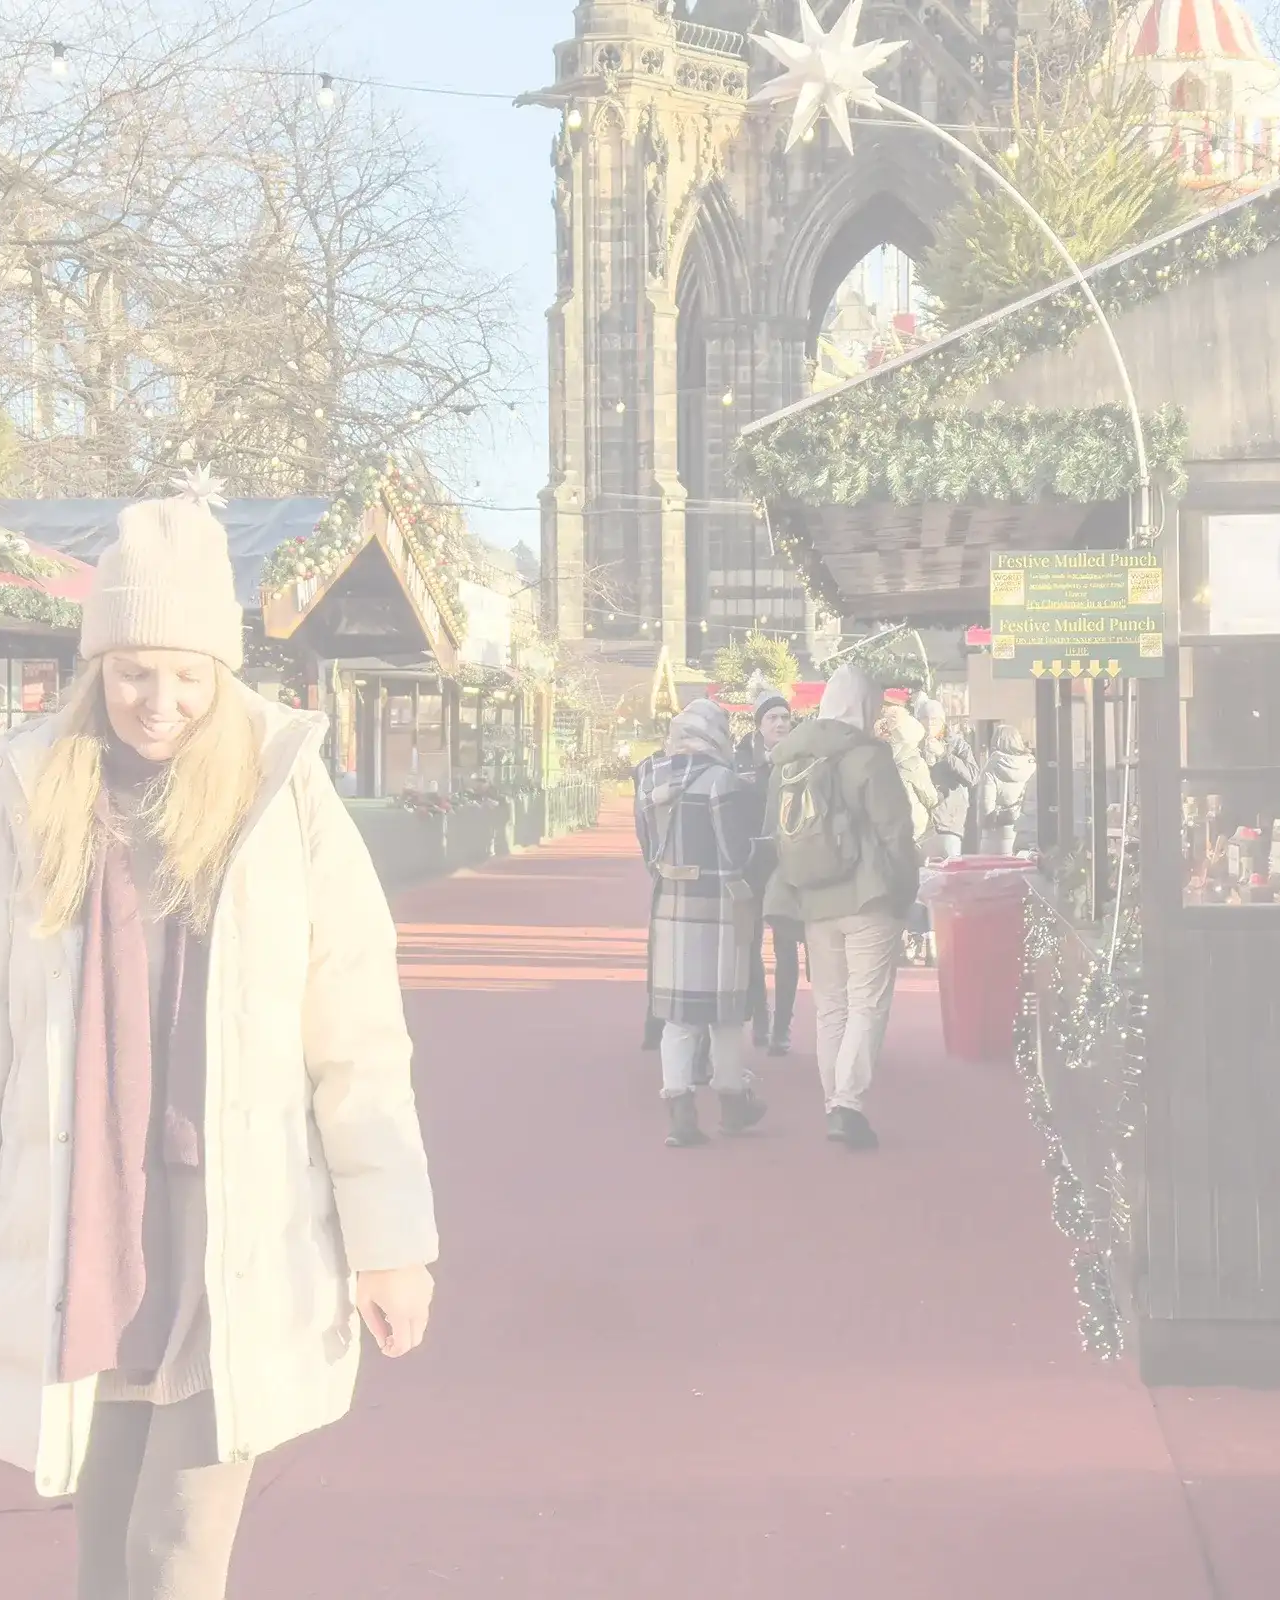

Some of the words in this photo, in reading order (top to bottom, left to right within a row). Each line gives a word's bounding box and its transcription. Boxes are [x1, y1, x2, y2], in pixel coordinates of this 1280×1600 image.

[998, 554, 1050, 568] Festive
[1054, 553, 1105, 567] Mulled
[1110, 552, 1157, 567] Punch
[999, 618, 1050, 632] Festive
[1055, 617, 1104, 632] Mulled
[1109, 616, 1156, 631] Punch
